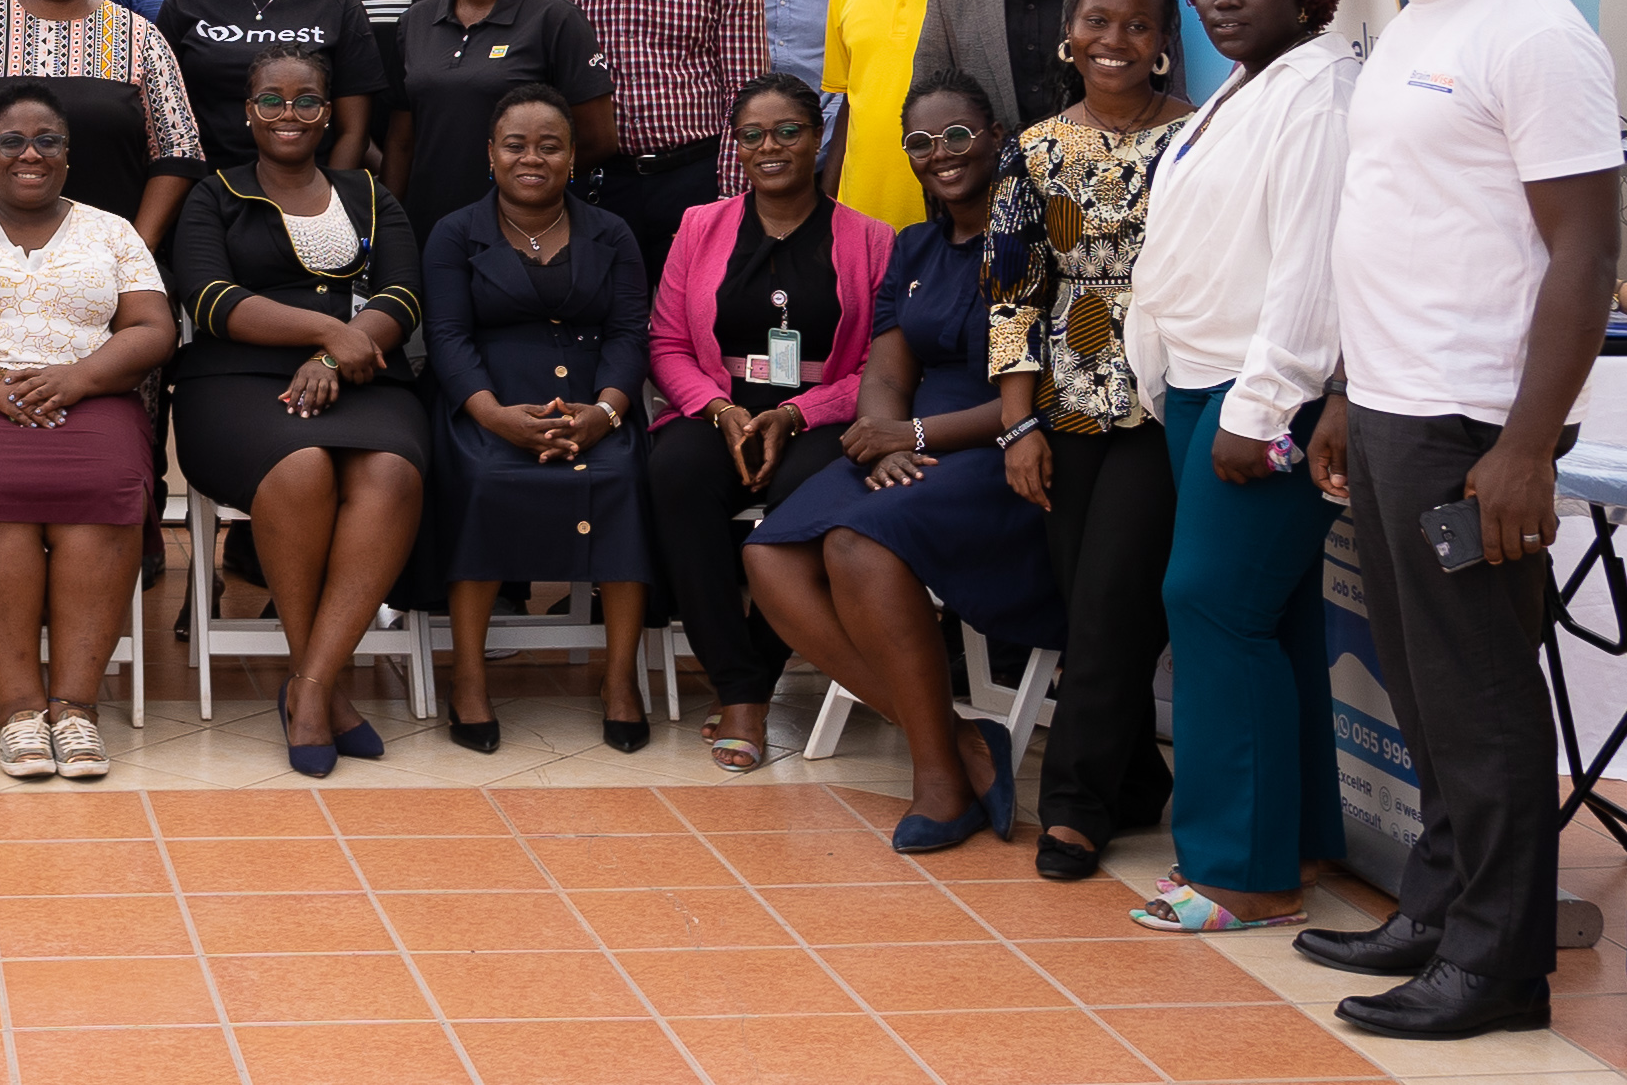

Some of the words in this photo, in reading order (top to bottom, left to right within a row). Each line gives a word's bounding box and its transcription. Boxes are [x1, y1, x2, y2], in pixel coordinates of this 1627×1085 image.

[246, 25, 325, 44] mest
[1331, 576, 1350, 598] Job
[1352, 722, 1380, 754] 055
[1382, 737, 1413, 770] 996
